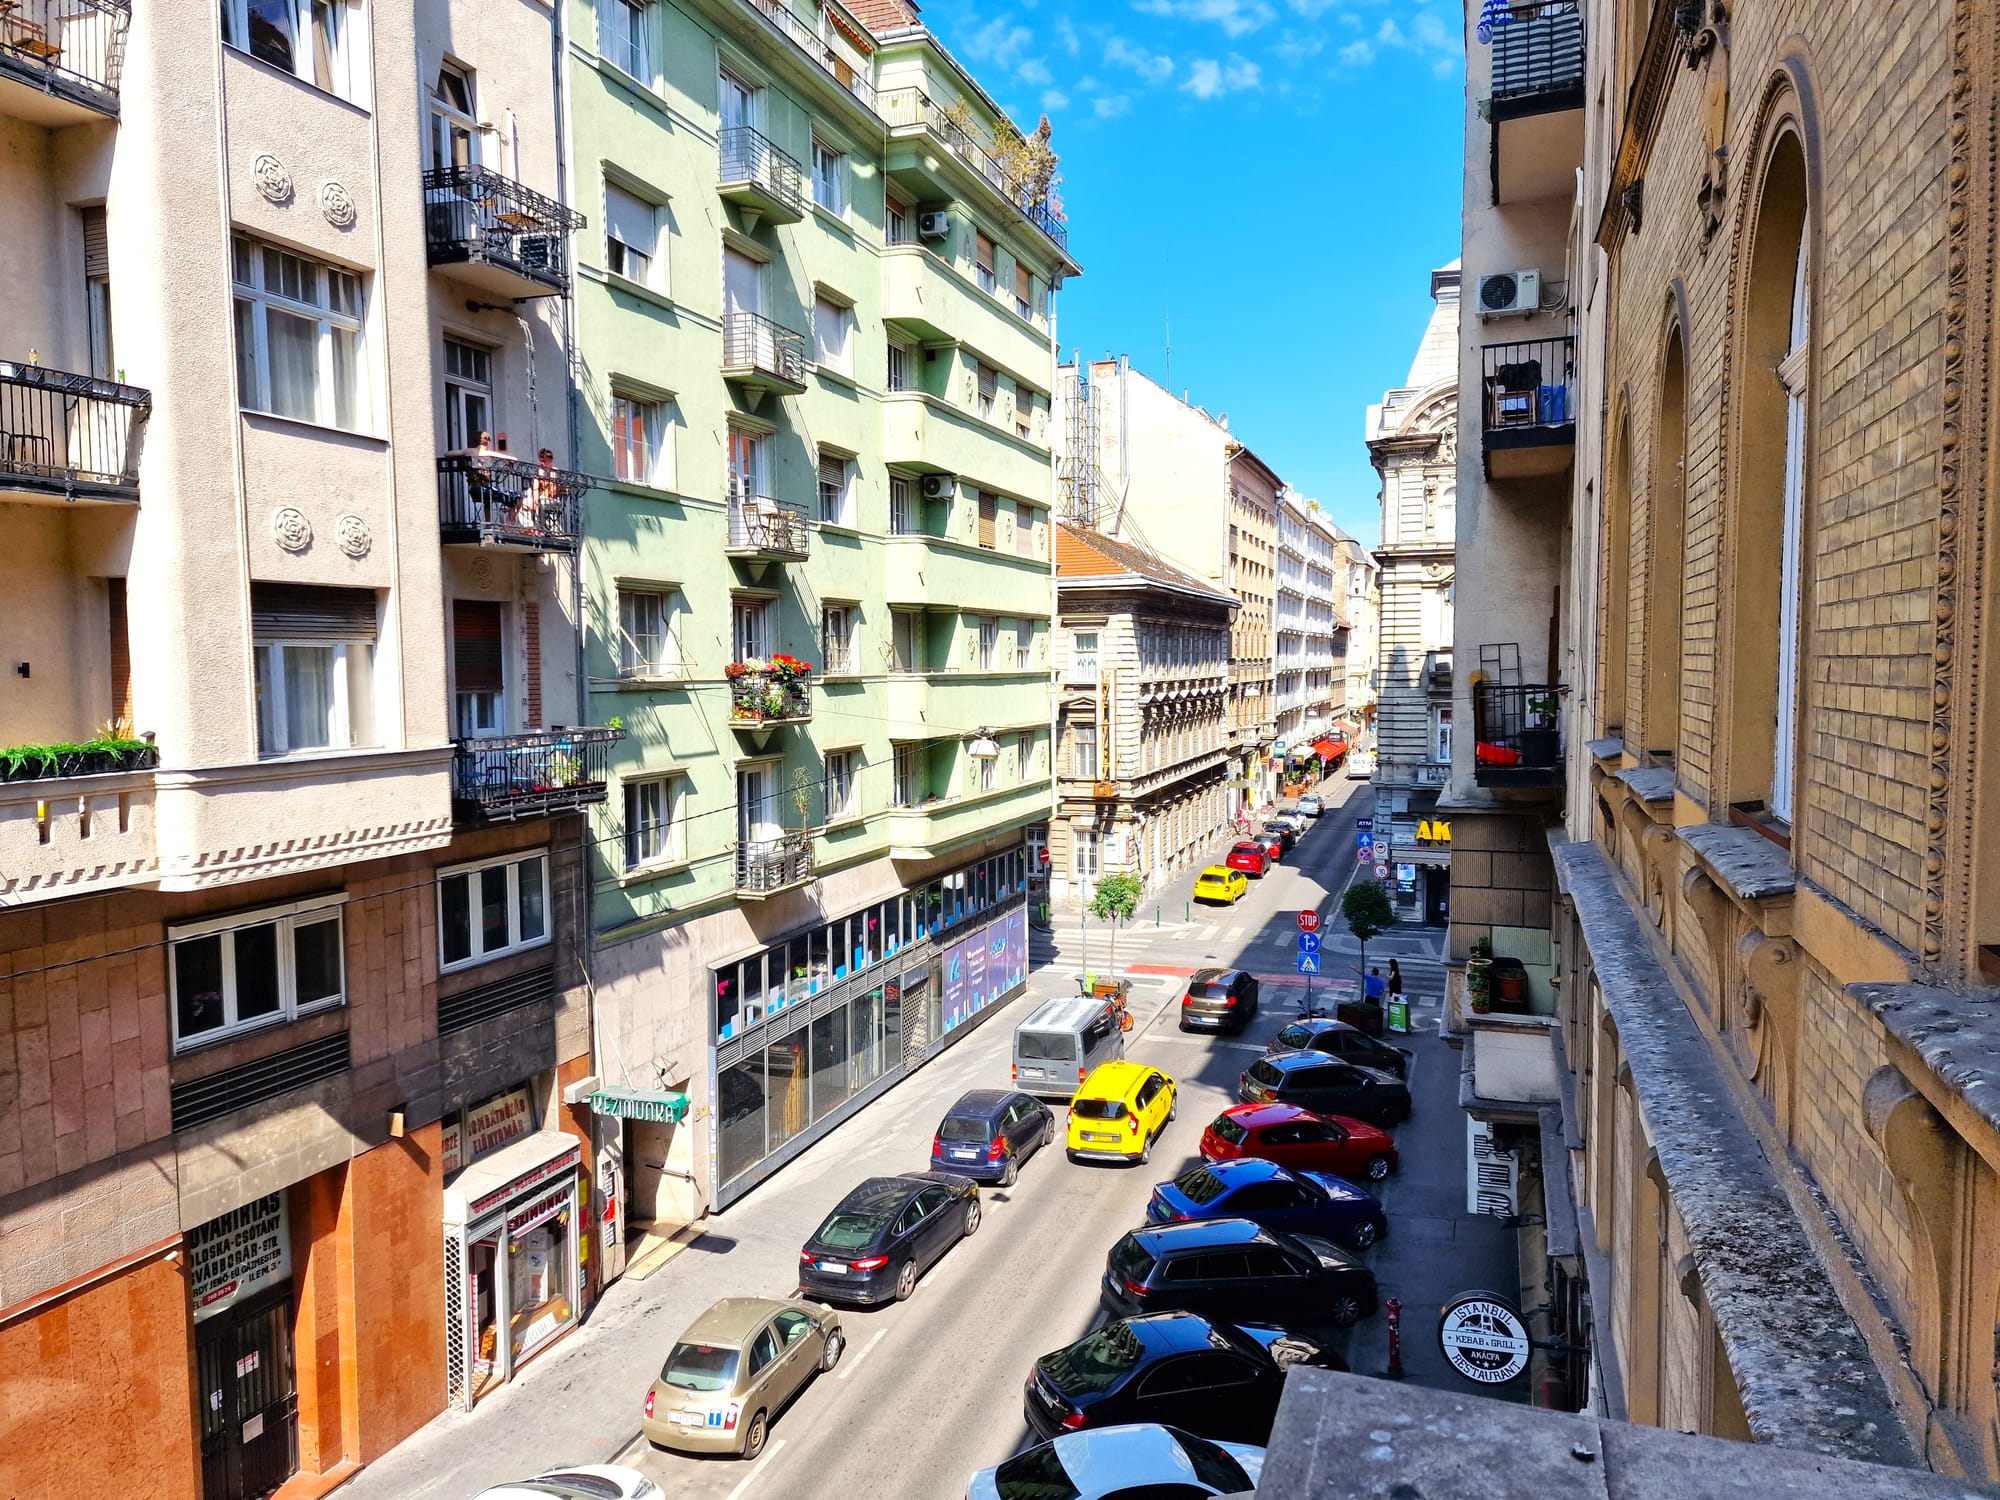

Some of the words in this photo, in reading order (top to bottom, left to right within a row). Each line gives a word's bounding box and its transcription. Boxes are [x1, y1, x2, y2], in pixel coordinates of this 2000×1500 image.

[1300, 914, 1317, 927] STOP
[1454, 1303, 1513, 1326] ISTANBUL
[1455, 1335, 1484, 1346] KEBAB
[1491, 1339, 1516, 1350] GRILL
[1471, 1351, 1500, 1361] AKÁCFA
[1452, 1353, 1521, 1381] RESTAURANT
